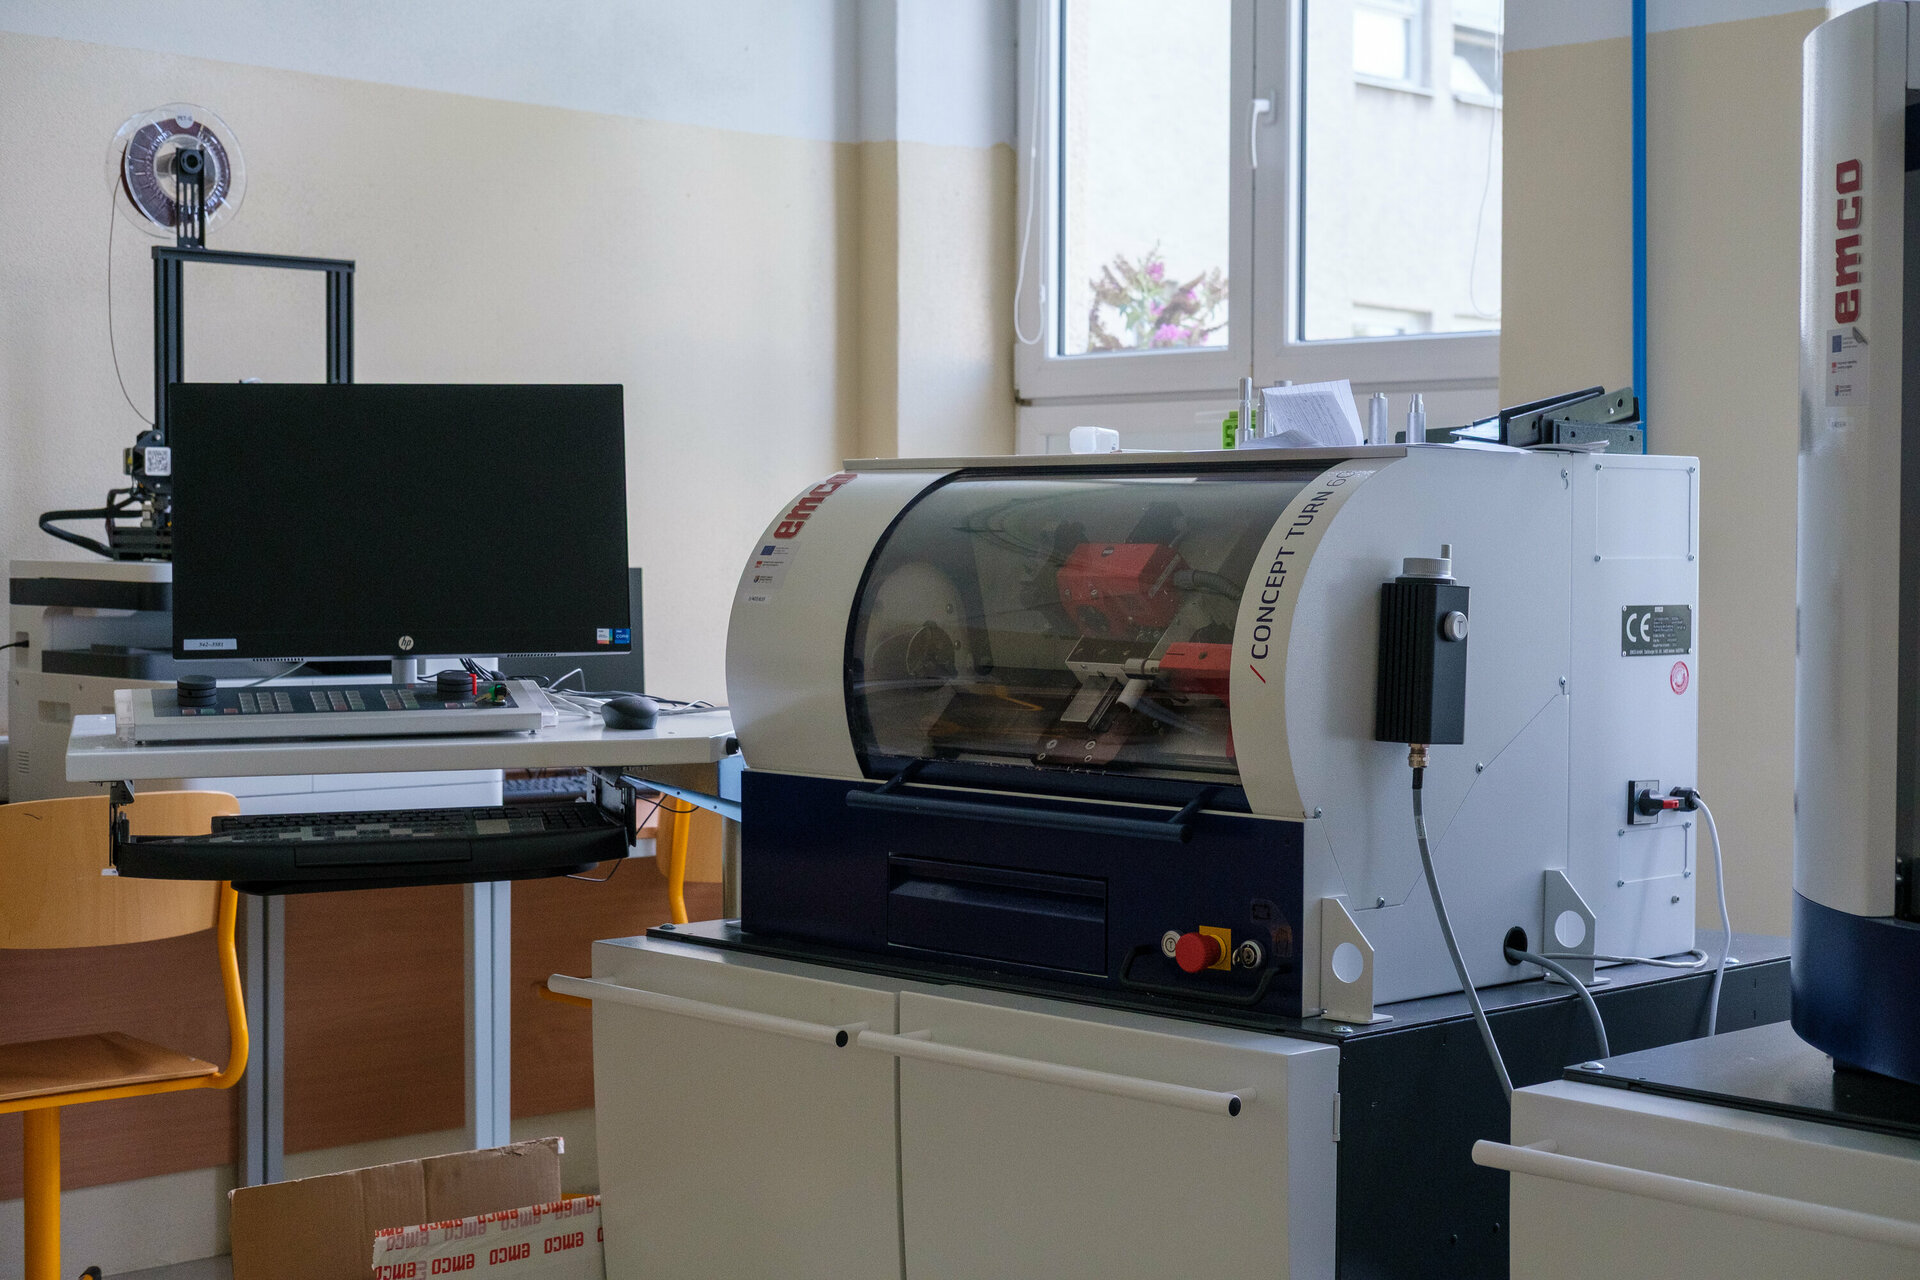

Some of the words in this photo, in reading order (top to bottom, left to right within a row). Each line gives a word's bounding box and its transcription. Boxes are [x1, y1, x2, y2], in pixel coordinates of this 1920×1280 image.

[1834, 158, 1862, 324] emco
[773, 473, 857, 539] emco
[1250, 547, 1295, 660] CONCEPT
[1284, 490, 1335, 540] TURN
[1626, 613, 1652, 643] CE
[400, 635, 413, 651] hp
[489, 1242, 531, 1266] emco
[543, 1231, 584, 1254] emco
[431, 1253, 476, 1276] emco
